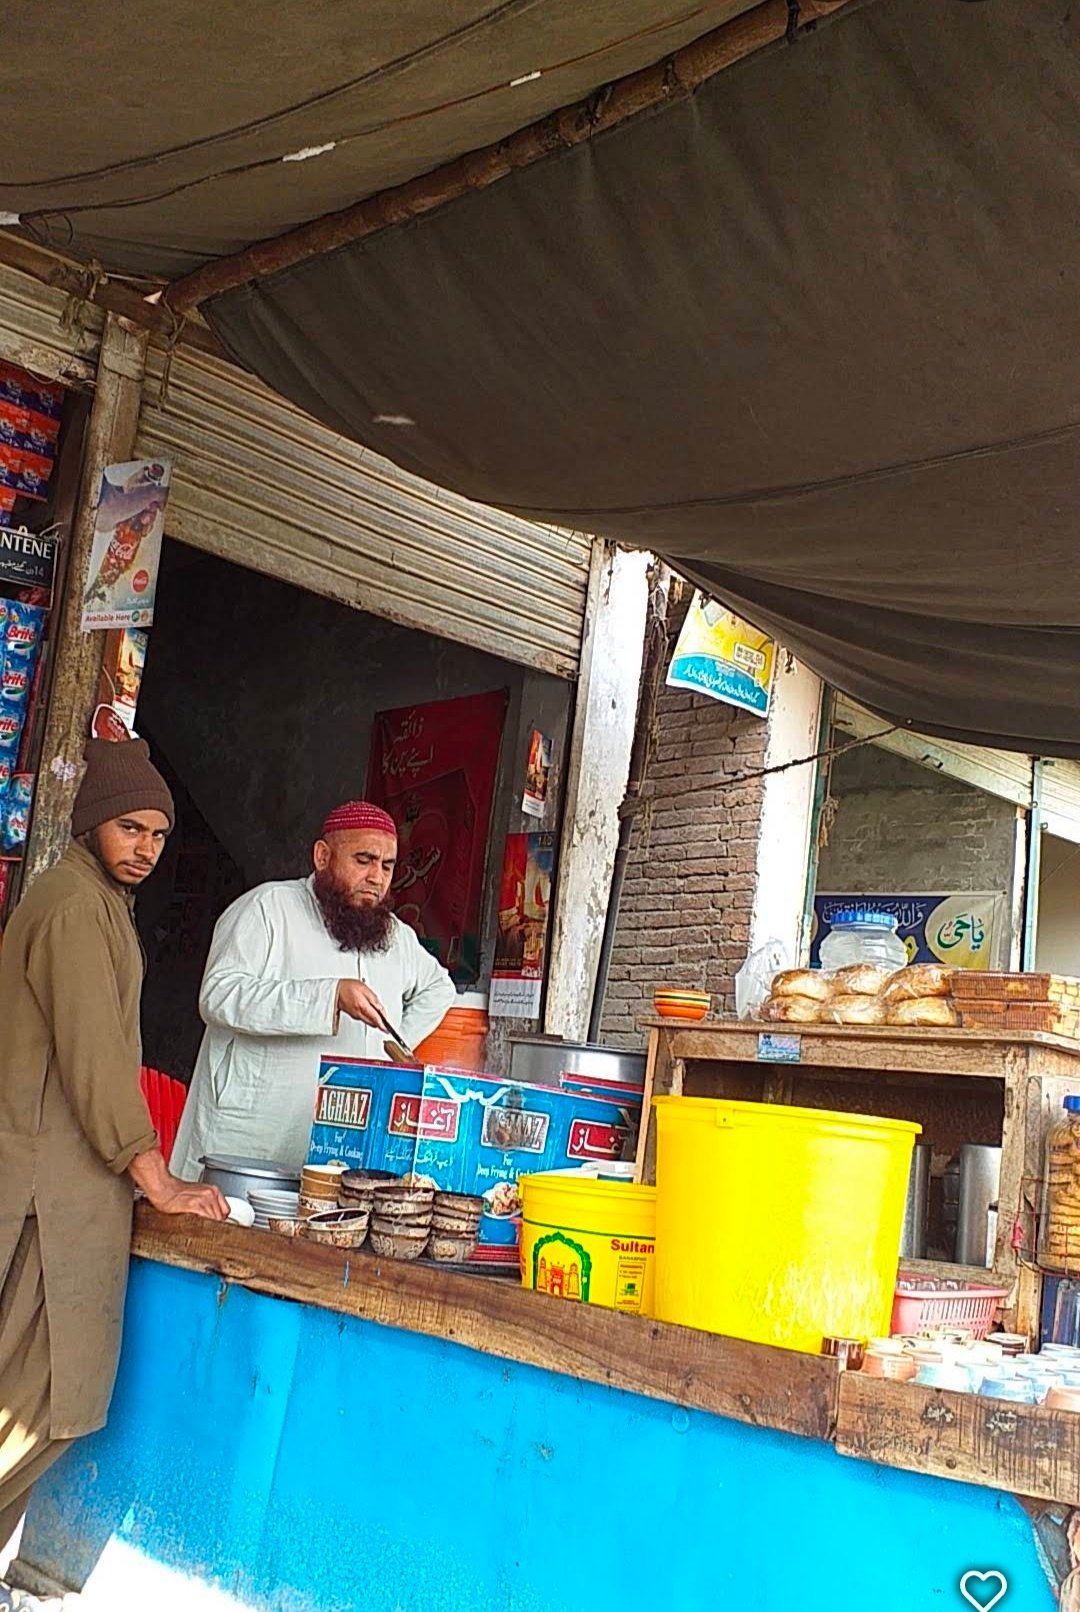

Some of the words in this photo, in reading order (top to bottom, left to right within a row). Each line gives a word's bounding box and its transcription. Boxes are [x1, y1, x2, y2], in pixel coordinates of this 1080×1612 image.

[0, 532, 53, 559] NTENE
[87, 613, 114, 623] Available
[116, 613, 131, 622] Here
[8, 623, 36, 642] Brite
[0, 718, 18, 732] rite
[318, 1089, 369, 1125] AGHAAZ
[503, 1153, 514, 1166] For
[477, 1163, 490, 1178] Deep
[490, 1166, 508, 1180] Frying
[610, 1238, 655, 1254] Sultan
